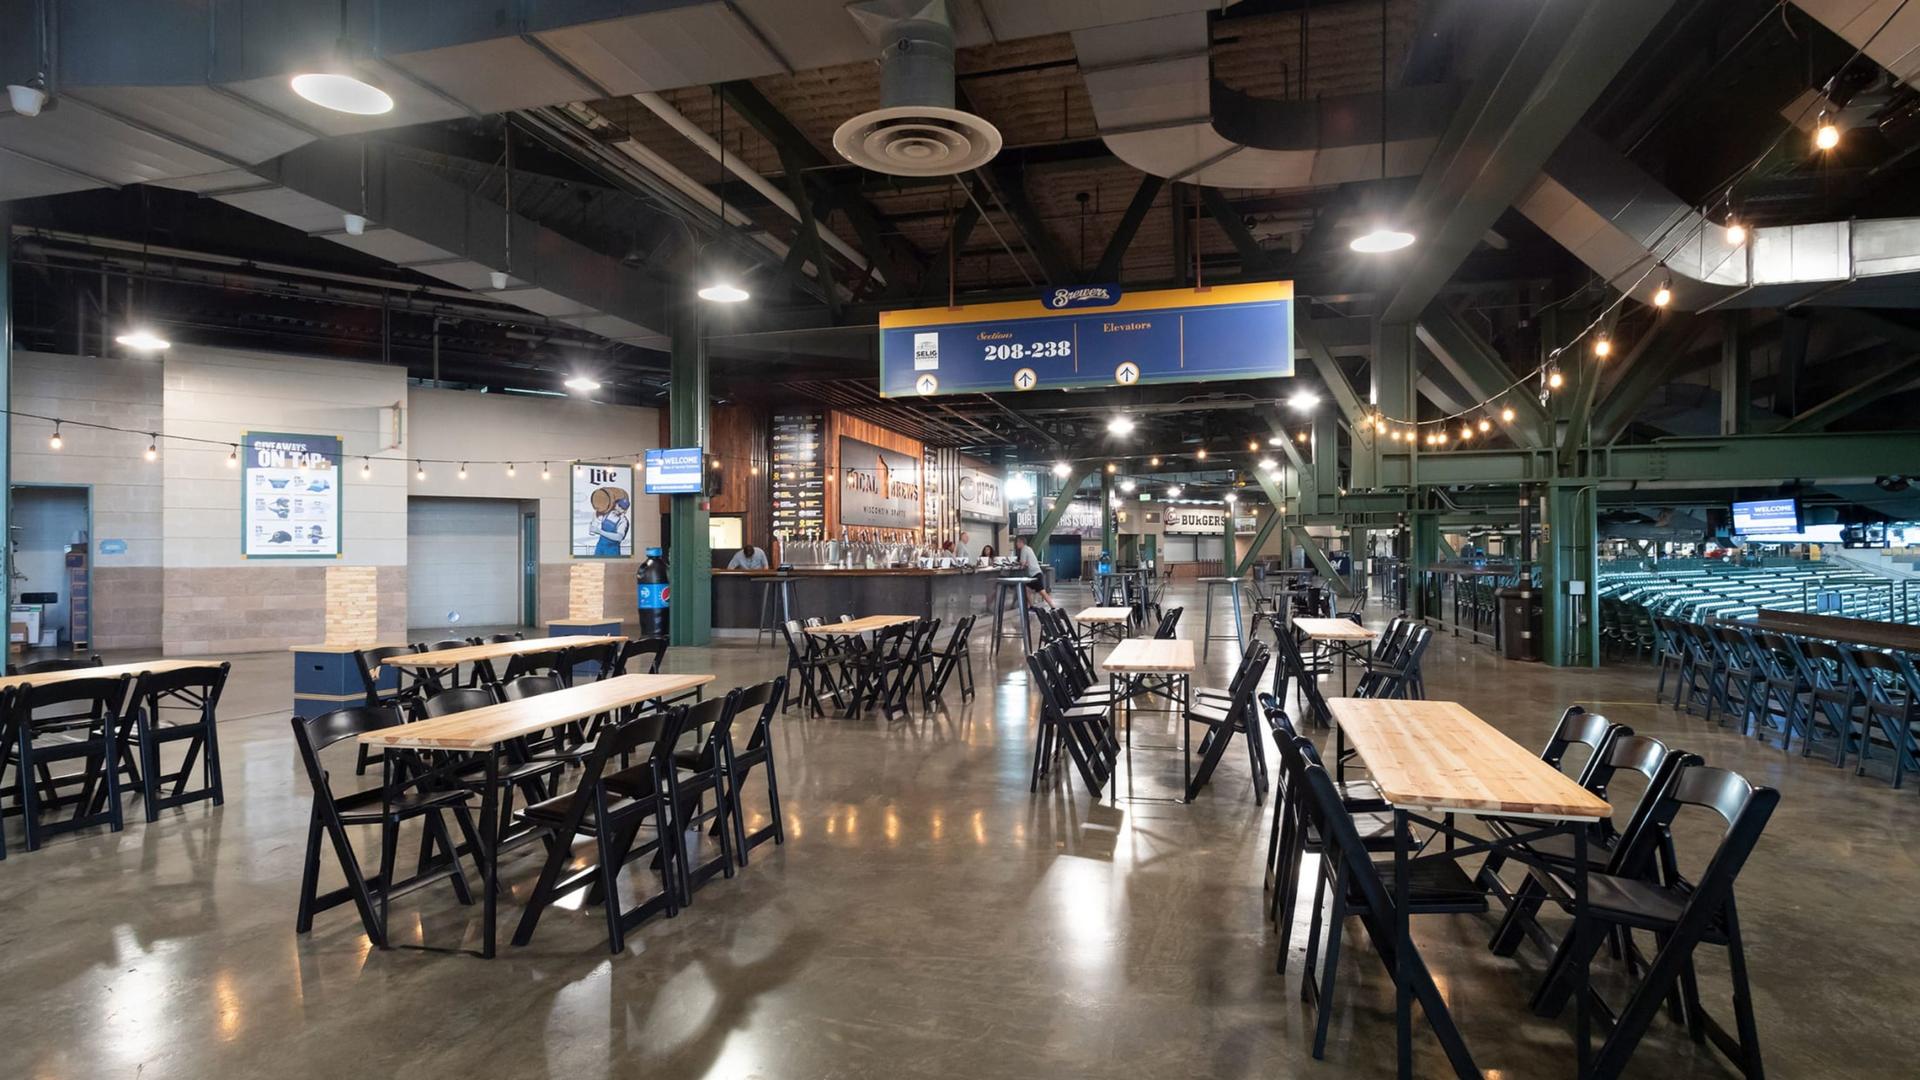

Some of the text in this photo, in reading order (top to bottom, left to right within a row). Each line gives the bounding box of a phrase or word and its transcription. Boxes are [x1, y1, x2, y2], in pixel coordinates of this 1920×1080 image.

[1052, 287, 1110, 308] Brewers
[1103, 322, 1152, 333] Elevators
[976, 331, 1013, 341] Sections
[984, 340, 1071, 361] 208-238
[254, 441, 307, 452] GIVEAWAYS
[258, 449, 285, 468] ON
[664, 456, 698, 465] WELCOME
[590, 469, 617, 485] Lite
[976, 481, 1001, 508] PIZZA
